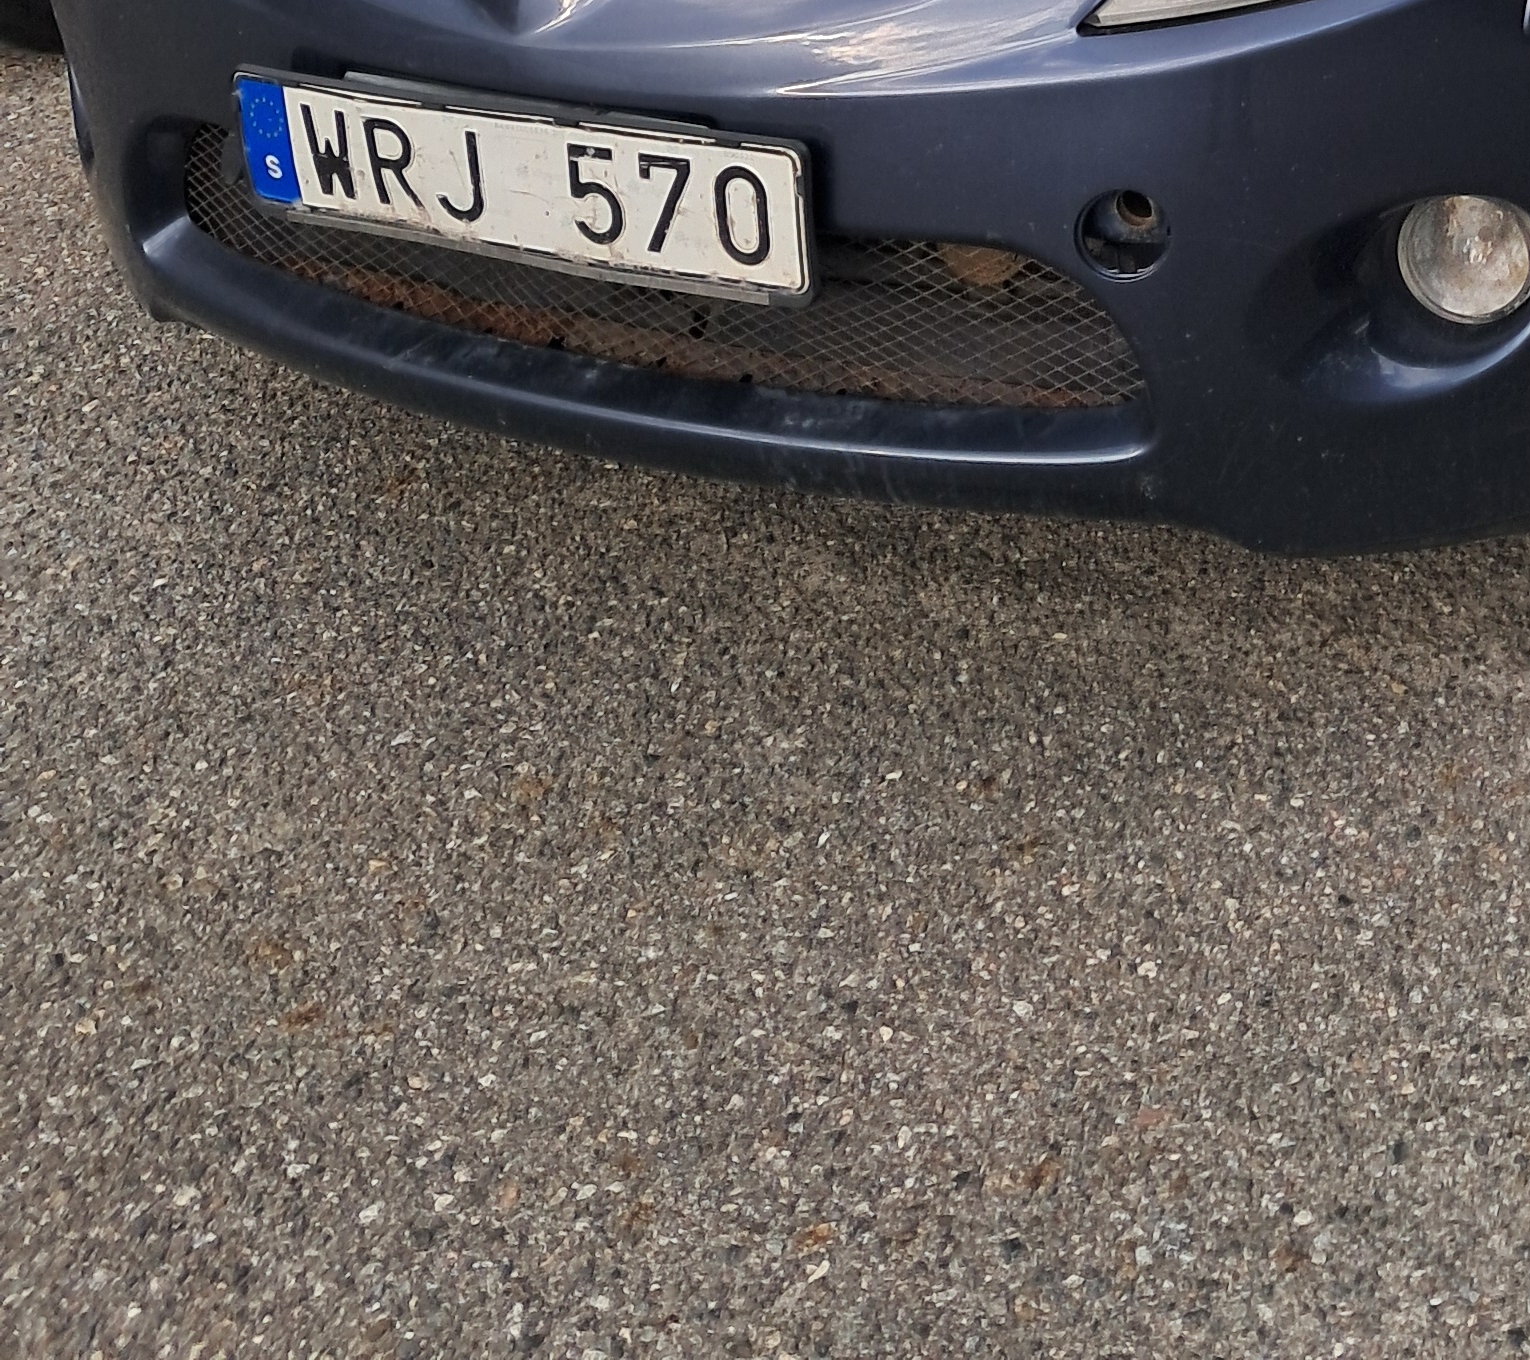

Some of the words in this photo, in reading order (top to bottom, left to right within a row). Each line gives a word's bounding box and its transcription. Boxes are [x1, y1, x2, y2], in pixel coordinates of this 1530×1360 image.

[267, 155, 283, 179] S
[300, 103, 487, 223] WRJ
[566, 143, 772, 267] 570
